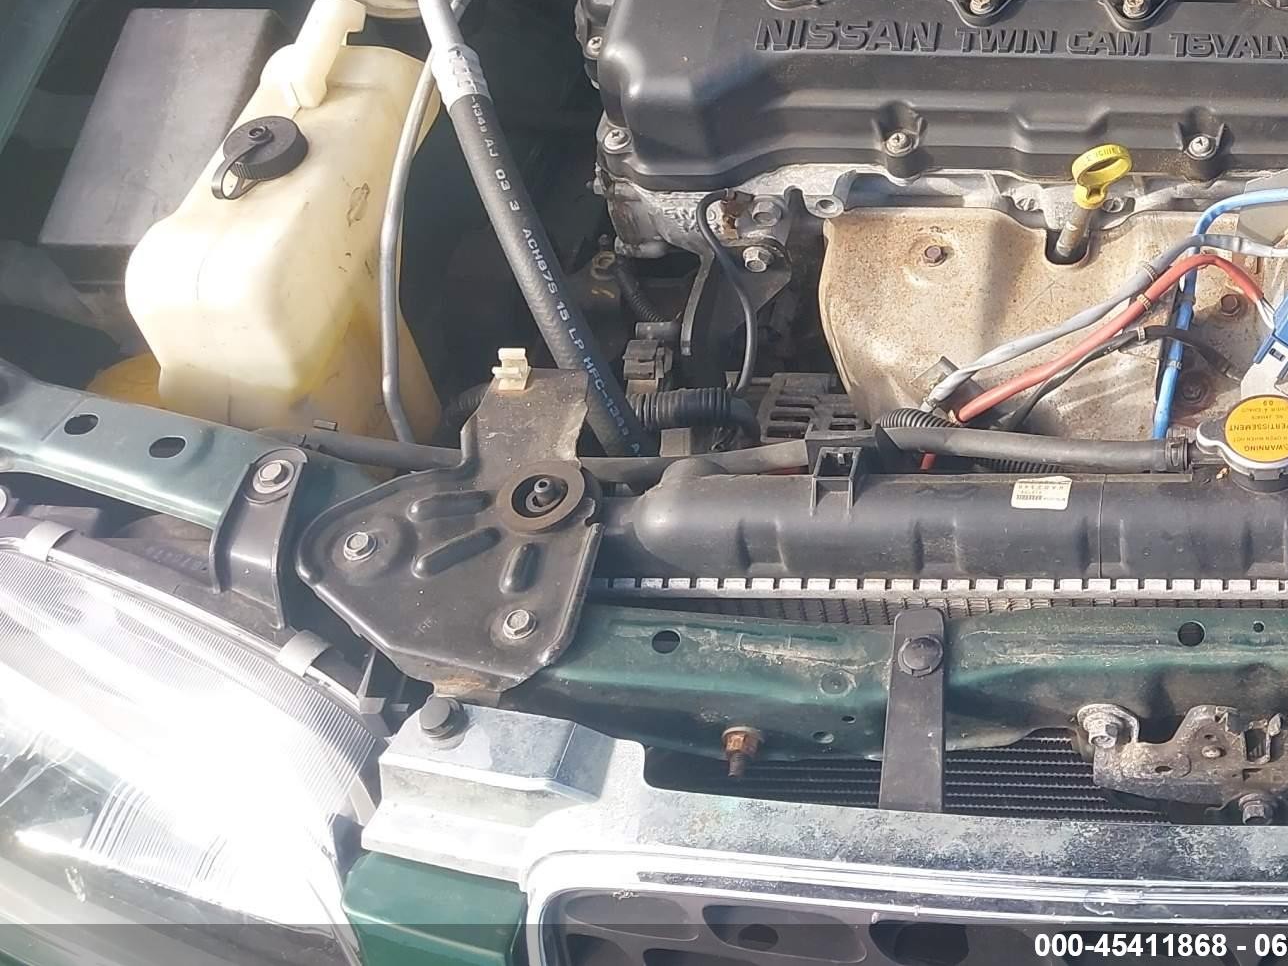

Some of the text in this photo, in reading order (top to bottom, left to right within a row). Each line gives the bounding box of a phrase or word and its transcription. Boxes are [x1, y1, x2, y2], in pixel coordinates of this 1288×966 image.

[754, 19, 945, 52] NISSAN
[955, 26, 1060, 55] TWIN
[1066, 30, 1151, 56] CAM
[509, 200, 521, 212] 3
[556, 300, 570, 322] 15
[568, 328, 585, 351] LP
